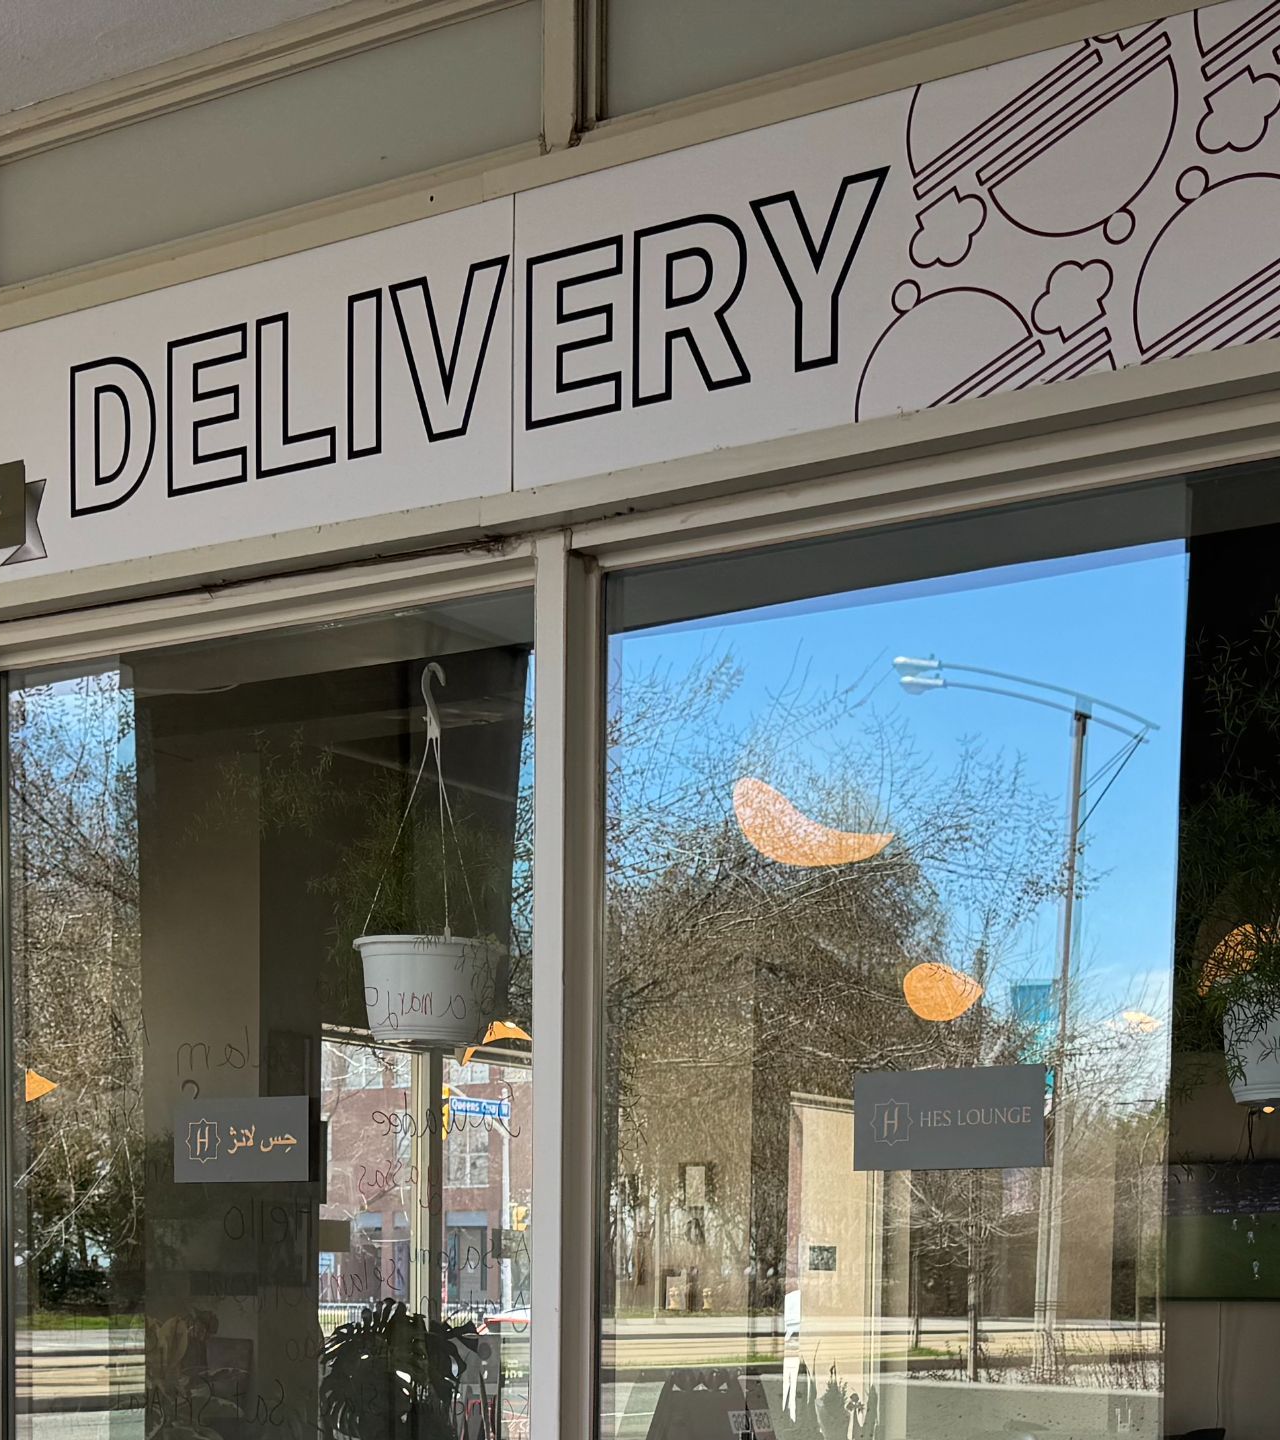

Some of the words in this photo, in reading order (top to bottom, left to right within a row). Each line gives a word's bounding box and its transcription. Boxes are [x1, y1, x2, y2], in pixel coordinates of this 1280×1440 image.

[69, 165, 889, 518] DELIVERY
[452, 1098, 480, 1112] Queens
[920, 1109, 951, 1127] HES
[958, 1106, 1031, 1126] LOUNGE
